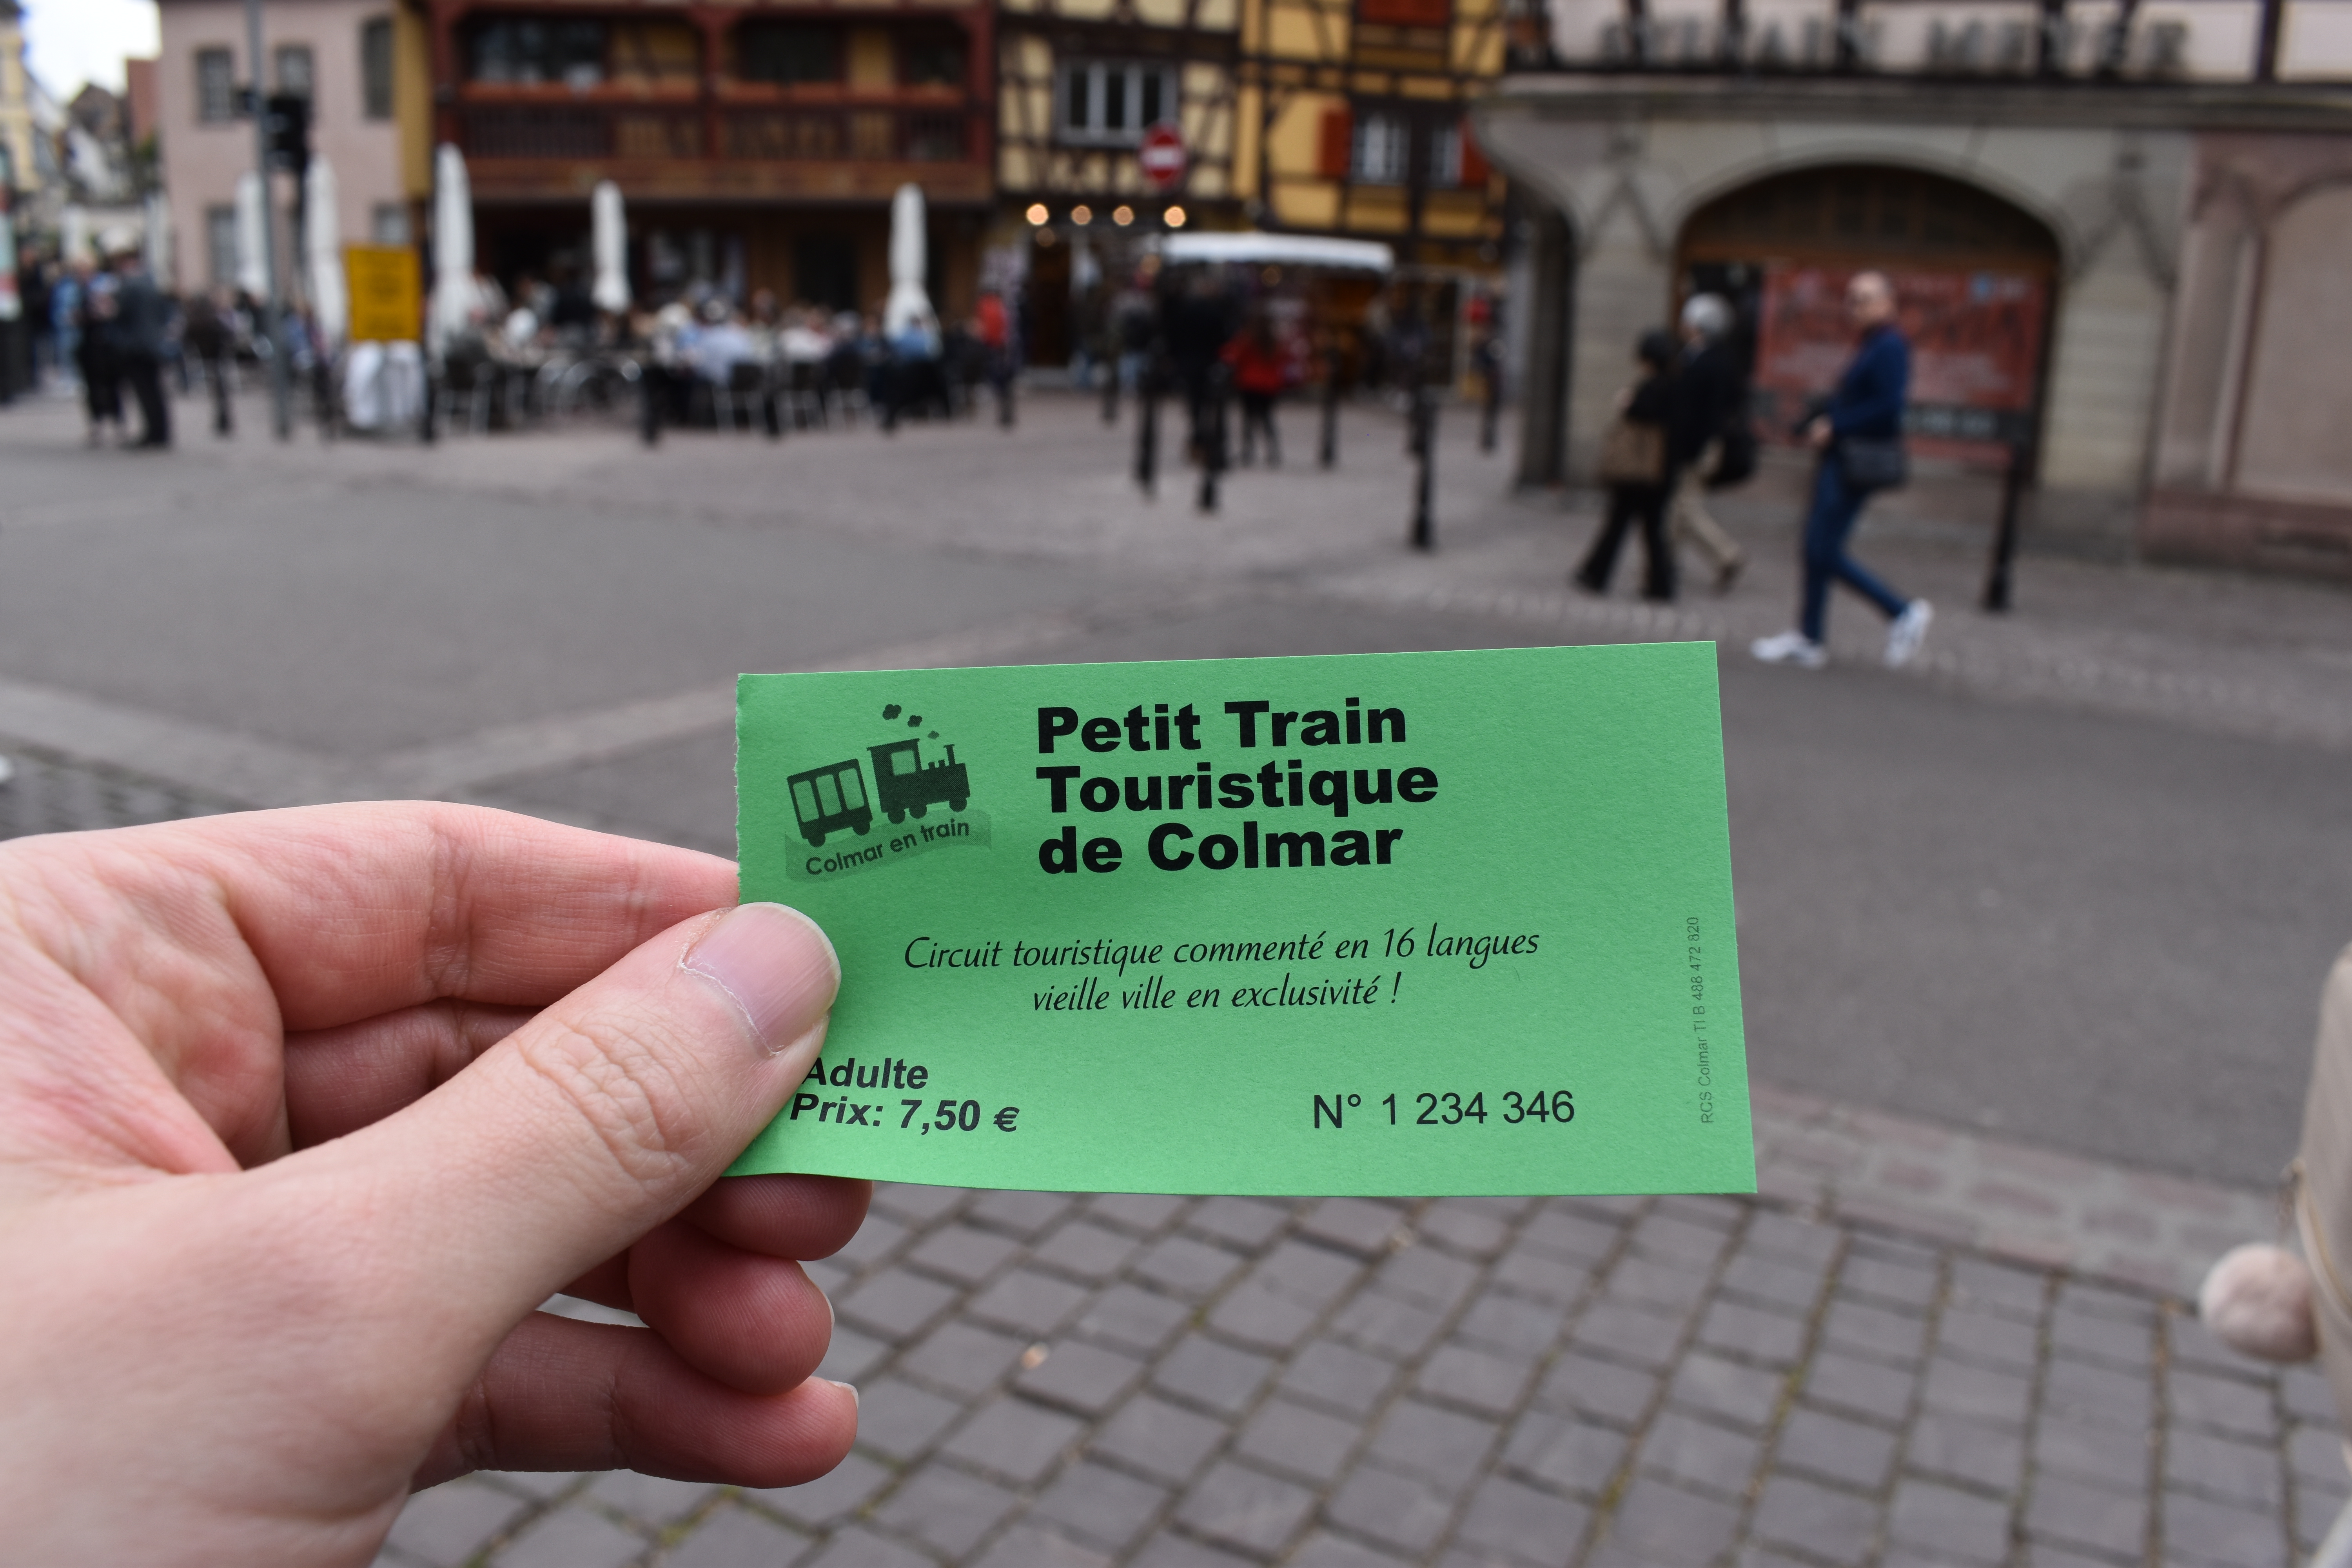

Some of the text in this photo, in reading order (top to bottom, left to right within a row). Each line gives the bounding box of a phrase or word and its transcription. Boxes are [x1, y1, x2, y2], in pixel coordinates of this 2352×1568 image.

[1037, 697, 1406, 754] Petit Train
[1035, 759, 1439, 818] Touristique
[806, 818, 969, 875] Colmar en train
[1038, 820, 1404, 875] de Colmar
[1686, 916, 1700, 942] 820
[904, 922, 1540, 978] Circuit touristique commenté en 16 langues
[1688, 946, 1701, 971] 472
[1034, 976, 1110, 1011] vieille
[1122, 975, 1176, 1009] ville
[1186, 988, 1220, 1009] en
[1231, 972, 1381, 1007] exclusivité
[1692, 1005, 1706, 1015] B
[800, 1056, 929, 1090] Adulte
[1696, 1036, 1711, 1086] Colmar
[789, 1093, 1020, 1136] Prix: 7,50 €
[1314, 1090, 1575, 1129] N° 1 234 346
[1699, 1091, 1714, 1123] RCS
